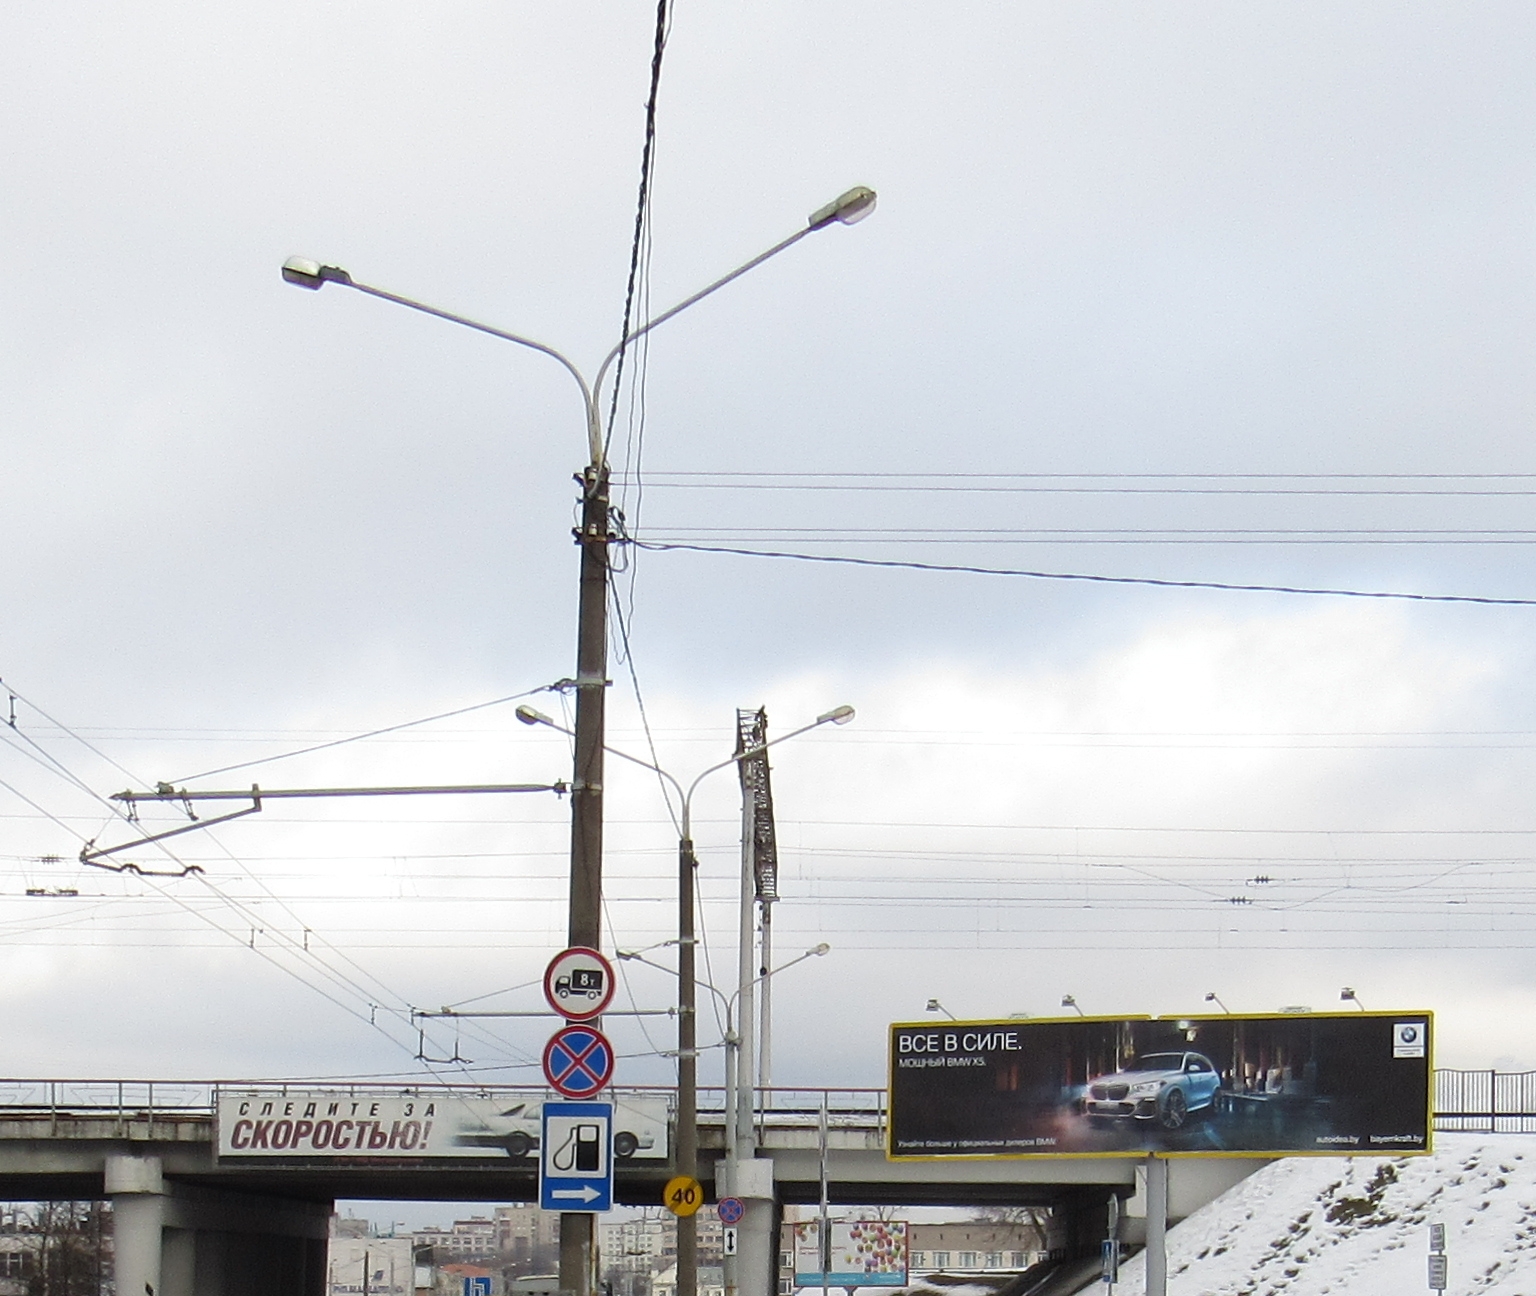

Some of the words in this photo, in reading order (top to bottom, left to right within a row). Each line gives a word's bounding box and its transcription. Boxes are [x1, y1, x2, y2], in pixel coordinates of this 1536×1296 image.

[899, 1034, 939, 1053] ВСЕ
[944, 1034, 958, 1052] В
[963, 1032, 1022, 1051] СИЛЕ.
[898, 1056, 945, 1069] МОЩНЫЙ
[947, 1057, 971, 1068] BMW
[238, 1102, 380, 1119] СЛЕДИТЕ
[403, 1103, 435, 1117] ЗА
[230, 1119, 433, 1150] СКОРОСТЬЮ!
[671, 1187, 695, 1205] 40
